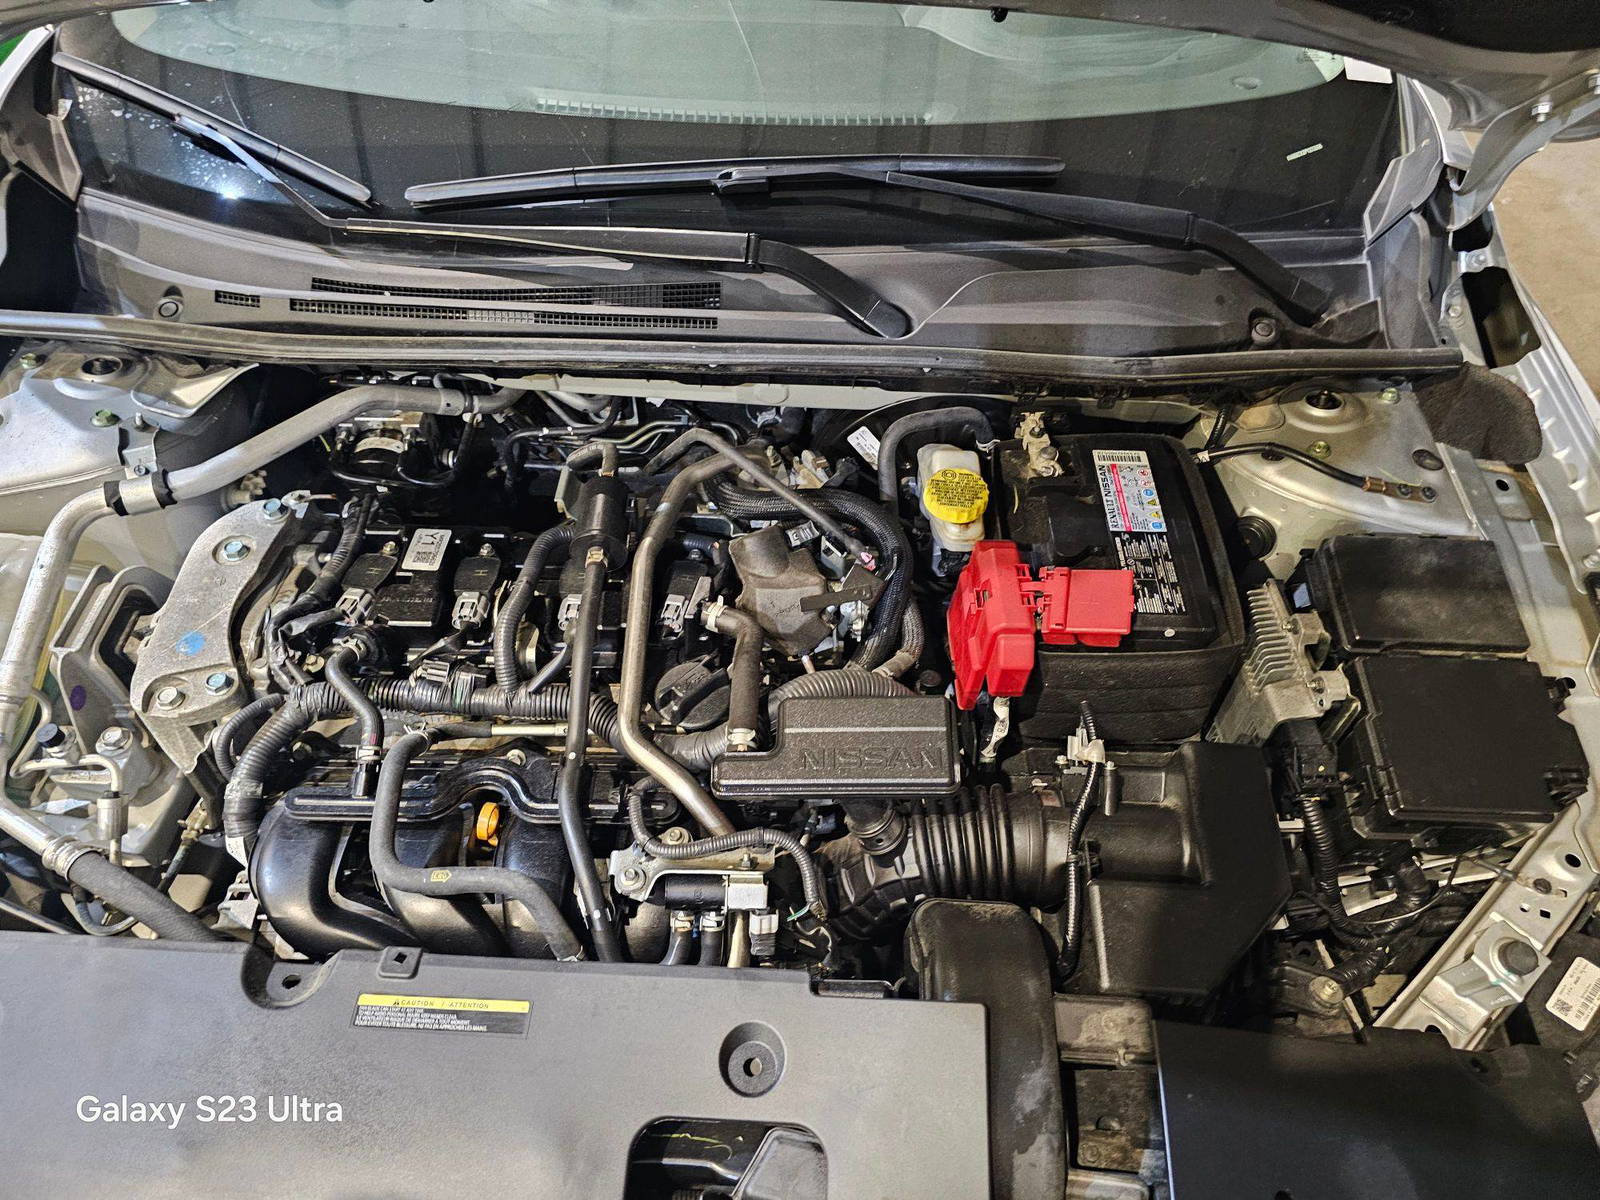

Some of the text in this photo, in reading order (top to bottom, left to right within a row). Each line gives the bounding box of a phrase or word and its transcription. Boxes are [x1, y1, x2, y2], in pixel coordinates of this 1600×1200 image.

[1098, 464, 1112, 497] NISSAN
[800, 748, 946, 770] NISSAN
[449, 1001, 489, 1009] ATTENTION
